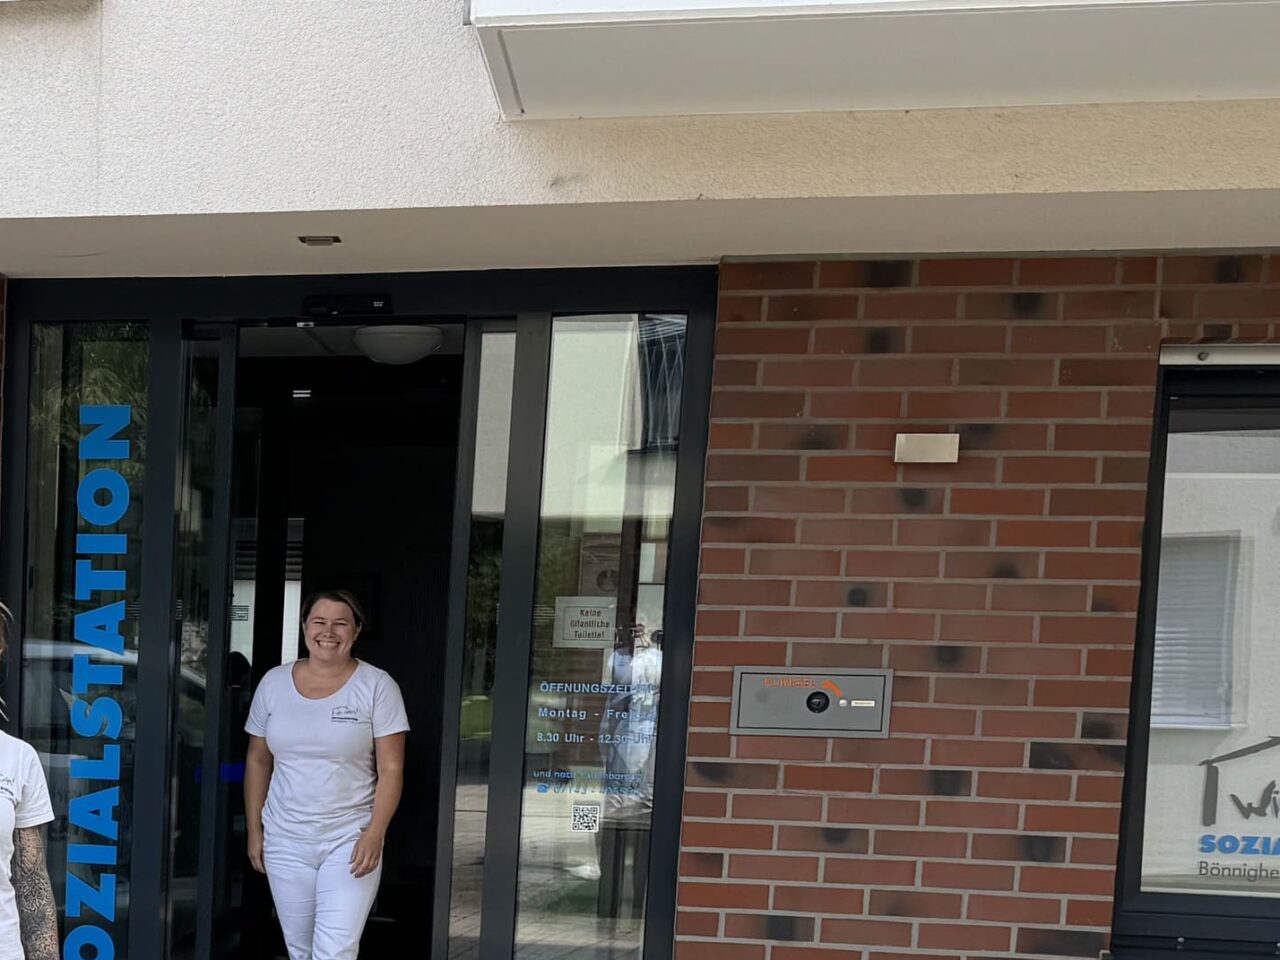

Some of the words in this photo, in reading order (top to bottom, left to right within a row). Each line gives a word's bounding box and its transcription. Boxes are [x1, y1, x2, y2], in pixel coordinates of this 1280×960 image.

[538, 707, 587, 720] Montag
[536, 732, 560, 743] 8.30
[564, 732, 585, 743] Uhr
